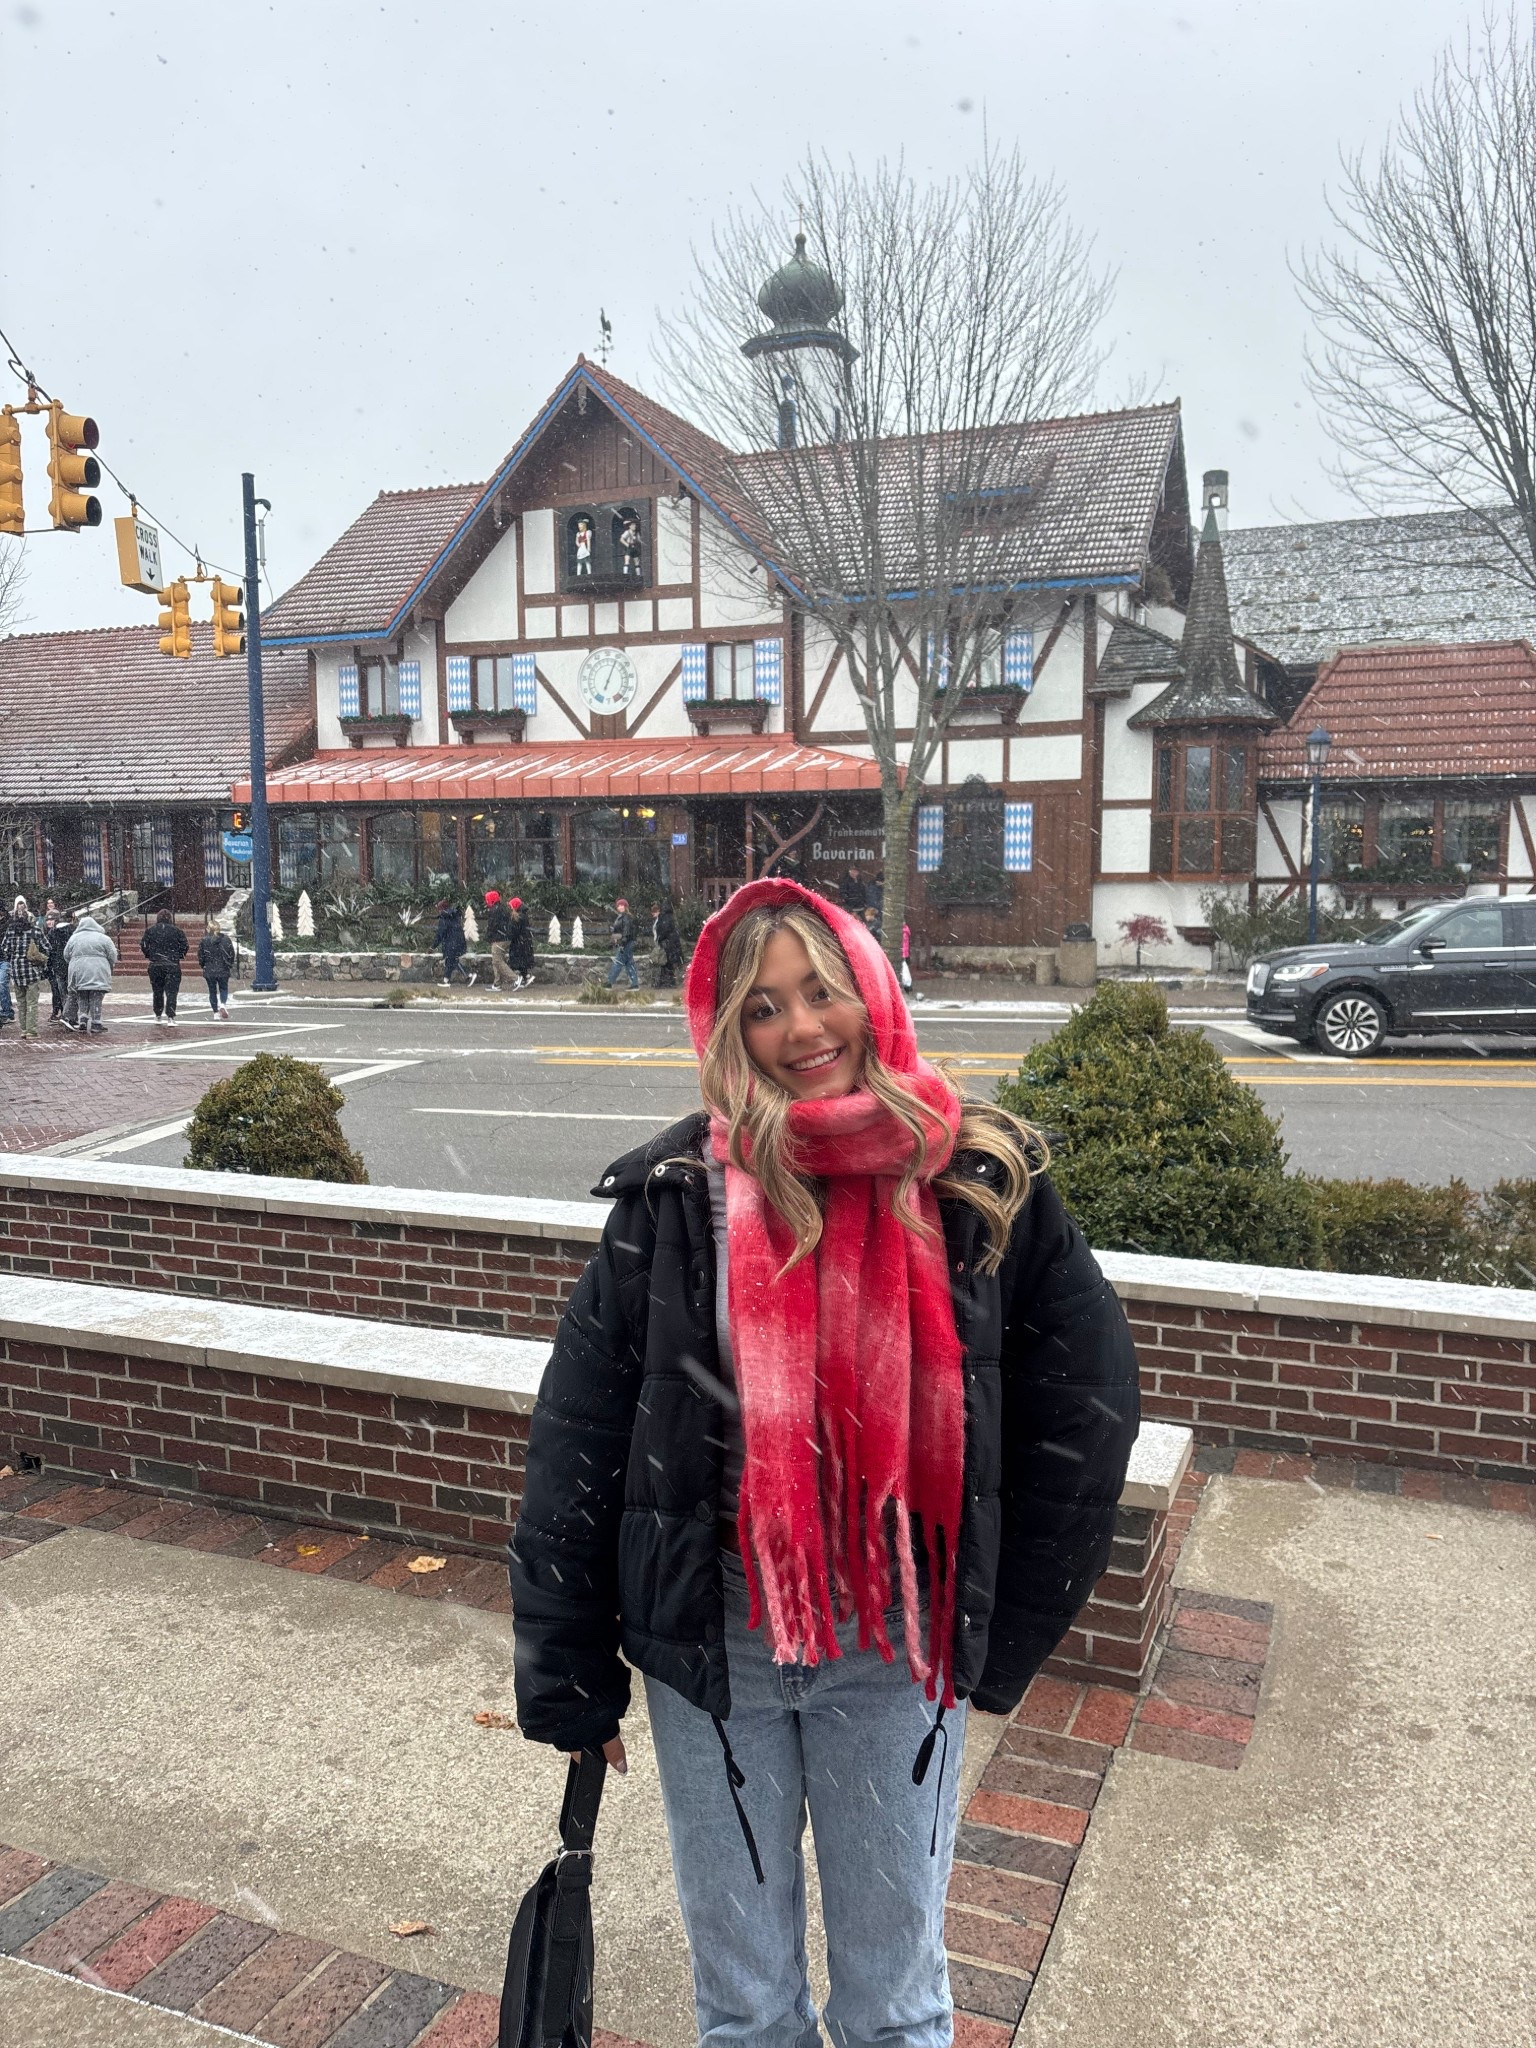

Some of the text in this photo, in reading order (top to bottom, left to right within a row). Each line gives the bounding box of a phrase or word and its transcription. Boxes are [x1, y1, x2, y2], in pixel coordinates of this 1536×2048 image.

[136, 526, 157, 548] CROSS
[139, 545, 158, 566] WALK
[812, 841, 875, 860] Bavarian
